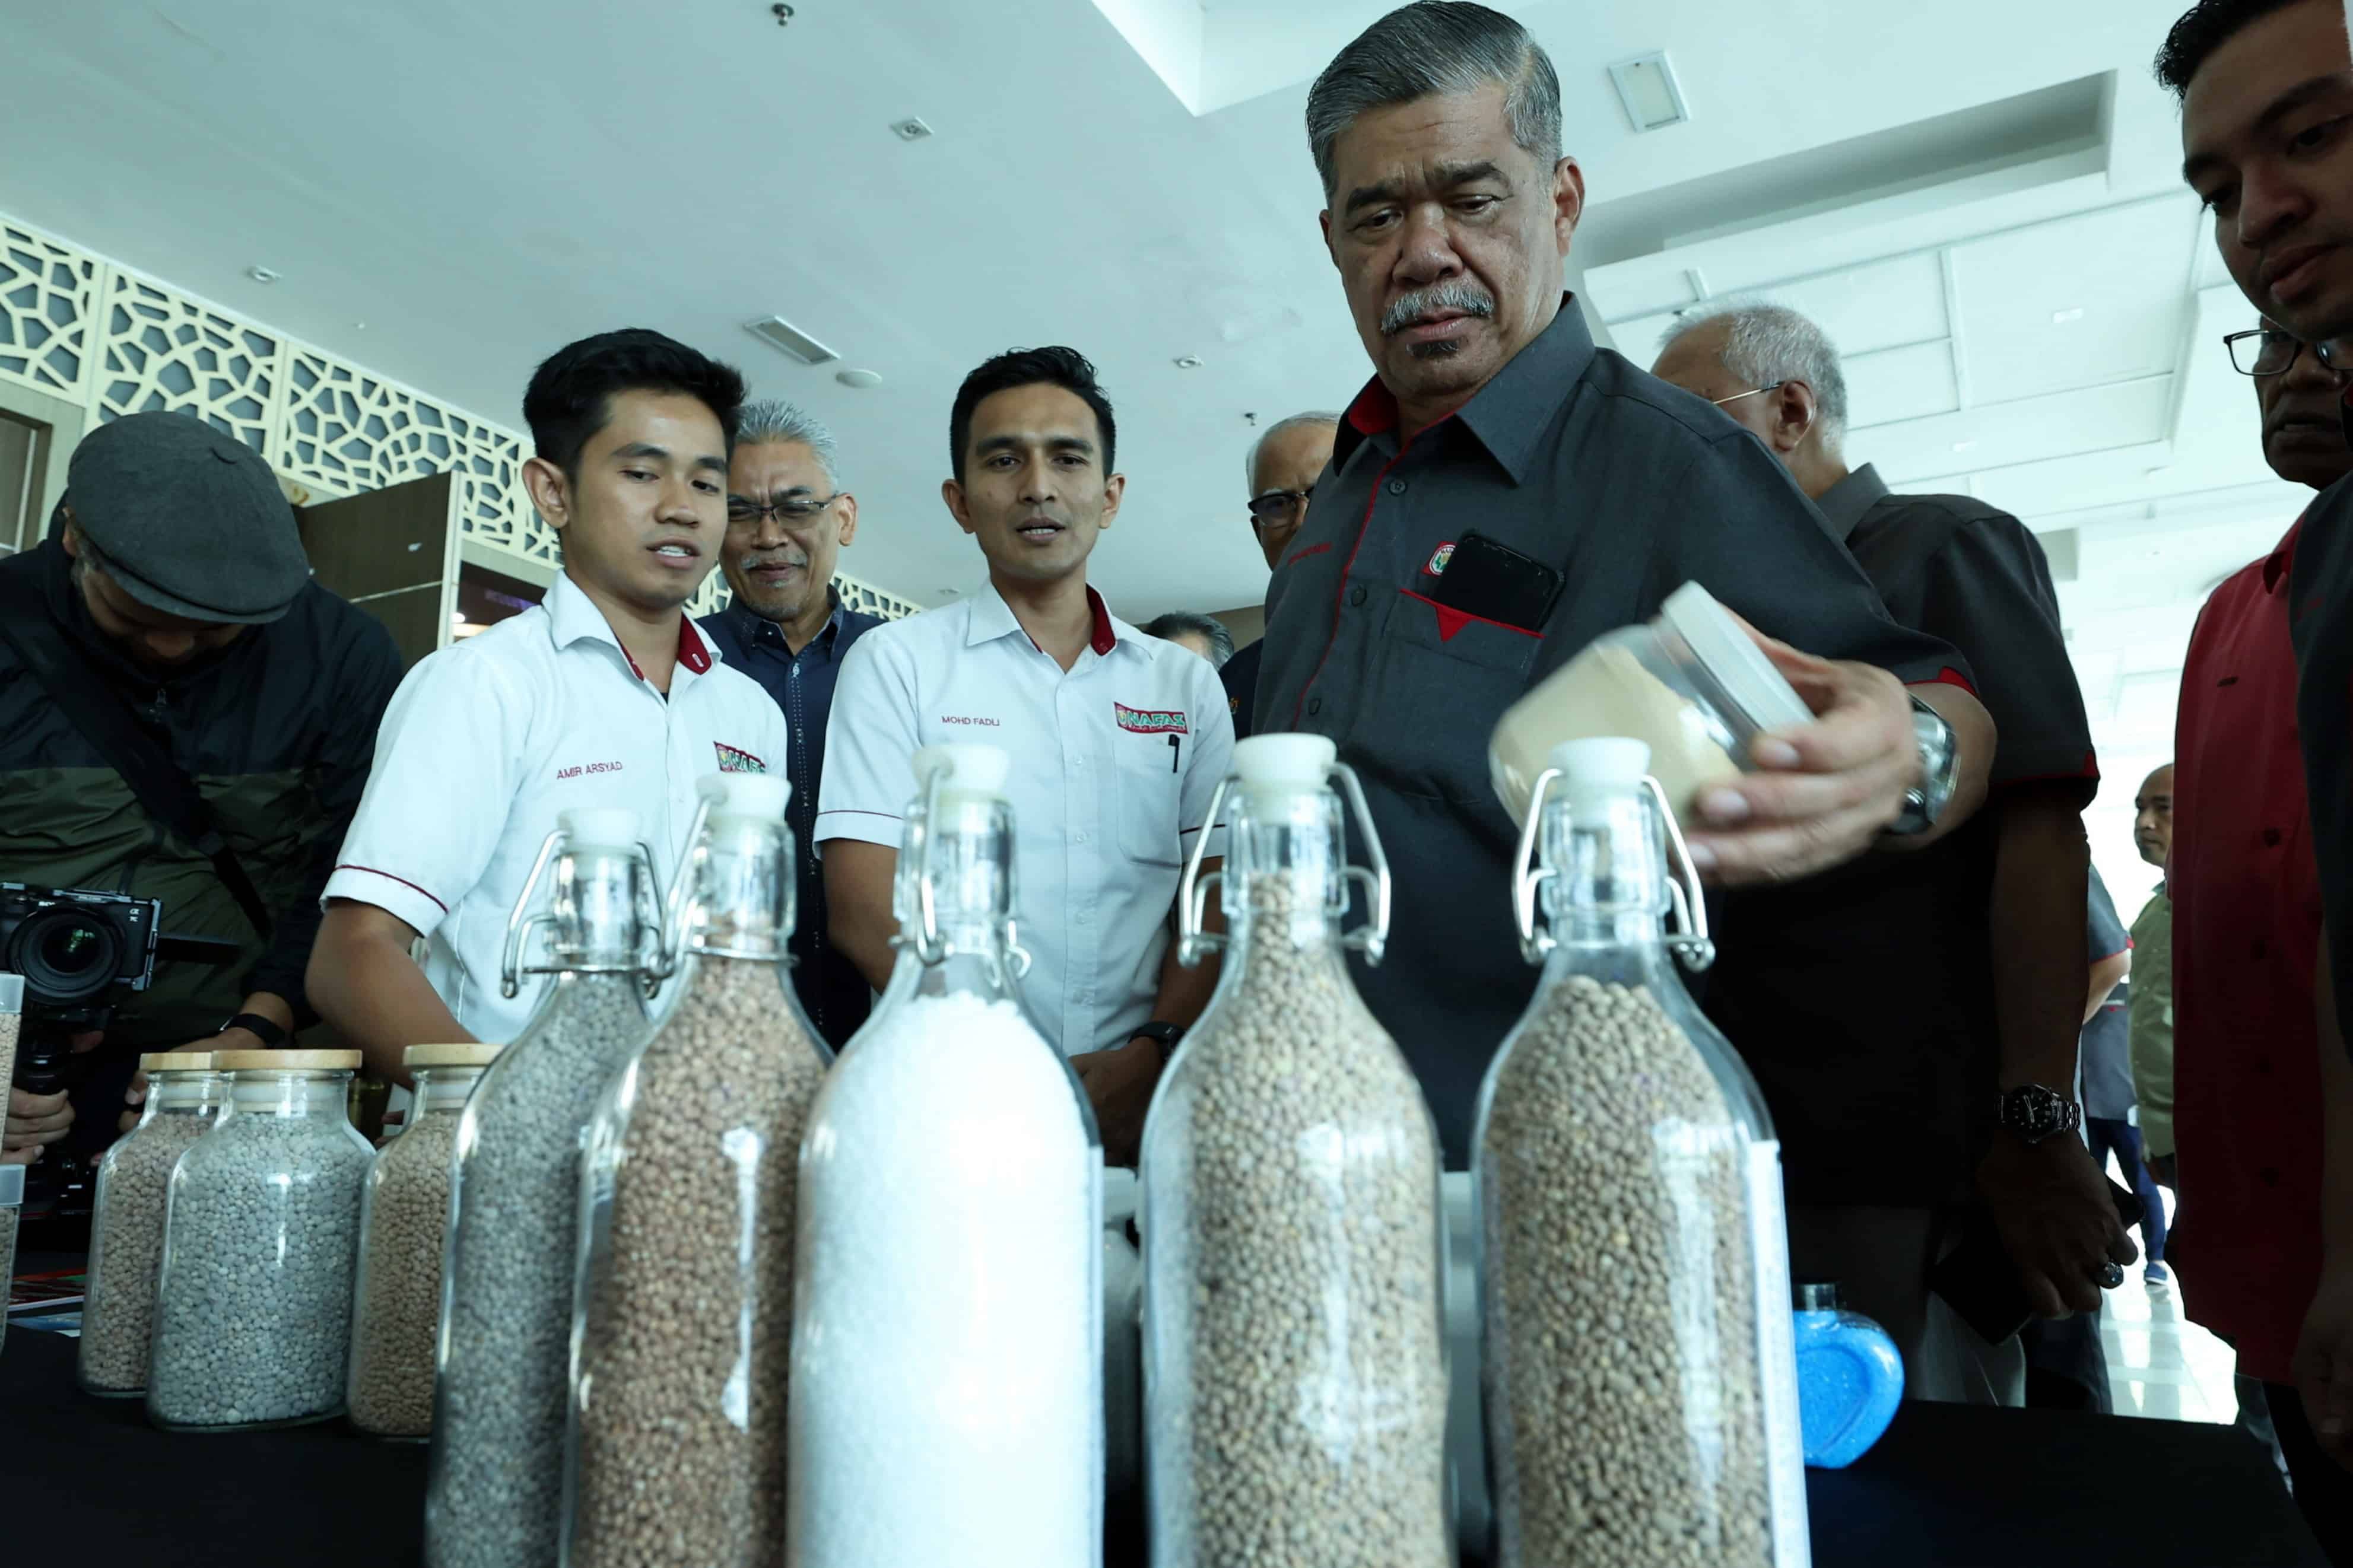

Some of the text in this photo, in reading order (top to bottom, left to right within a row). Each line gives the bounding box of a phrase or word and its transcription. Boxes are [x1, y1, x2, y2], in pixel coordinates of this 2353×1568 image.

[941, 715, 971, 725] MOHD
[557, 761, 623, 780] AMIR ARSYAD
